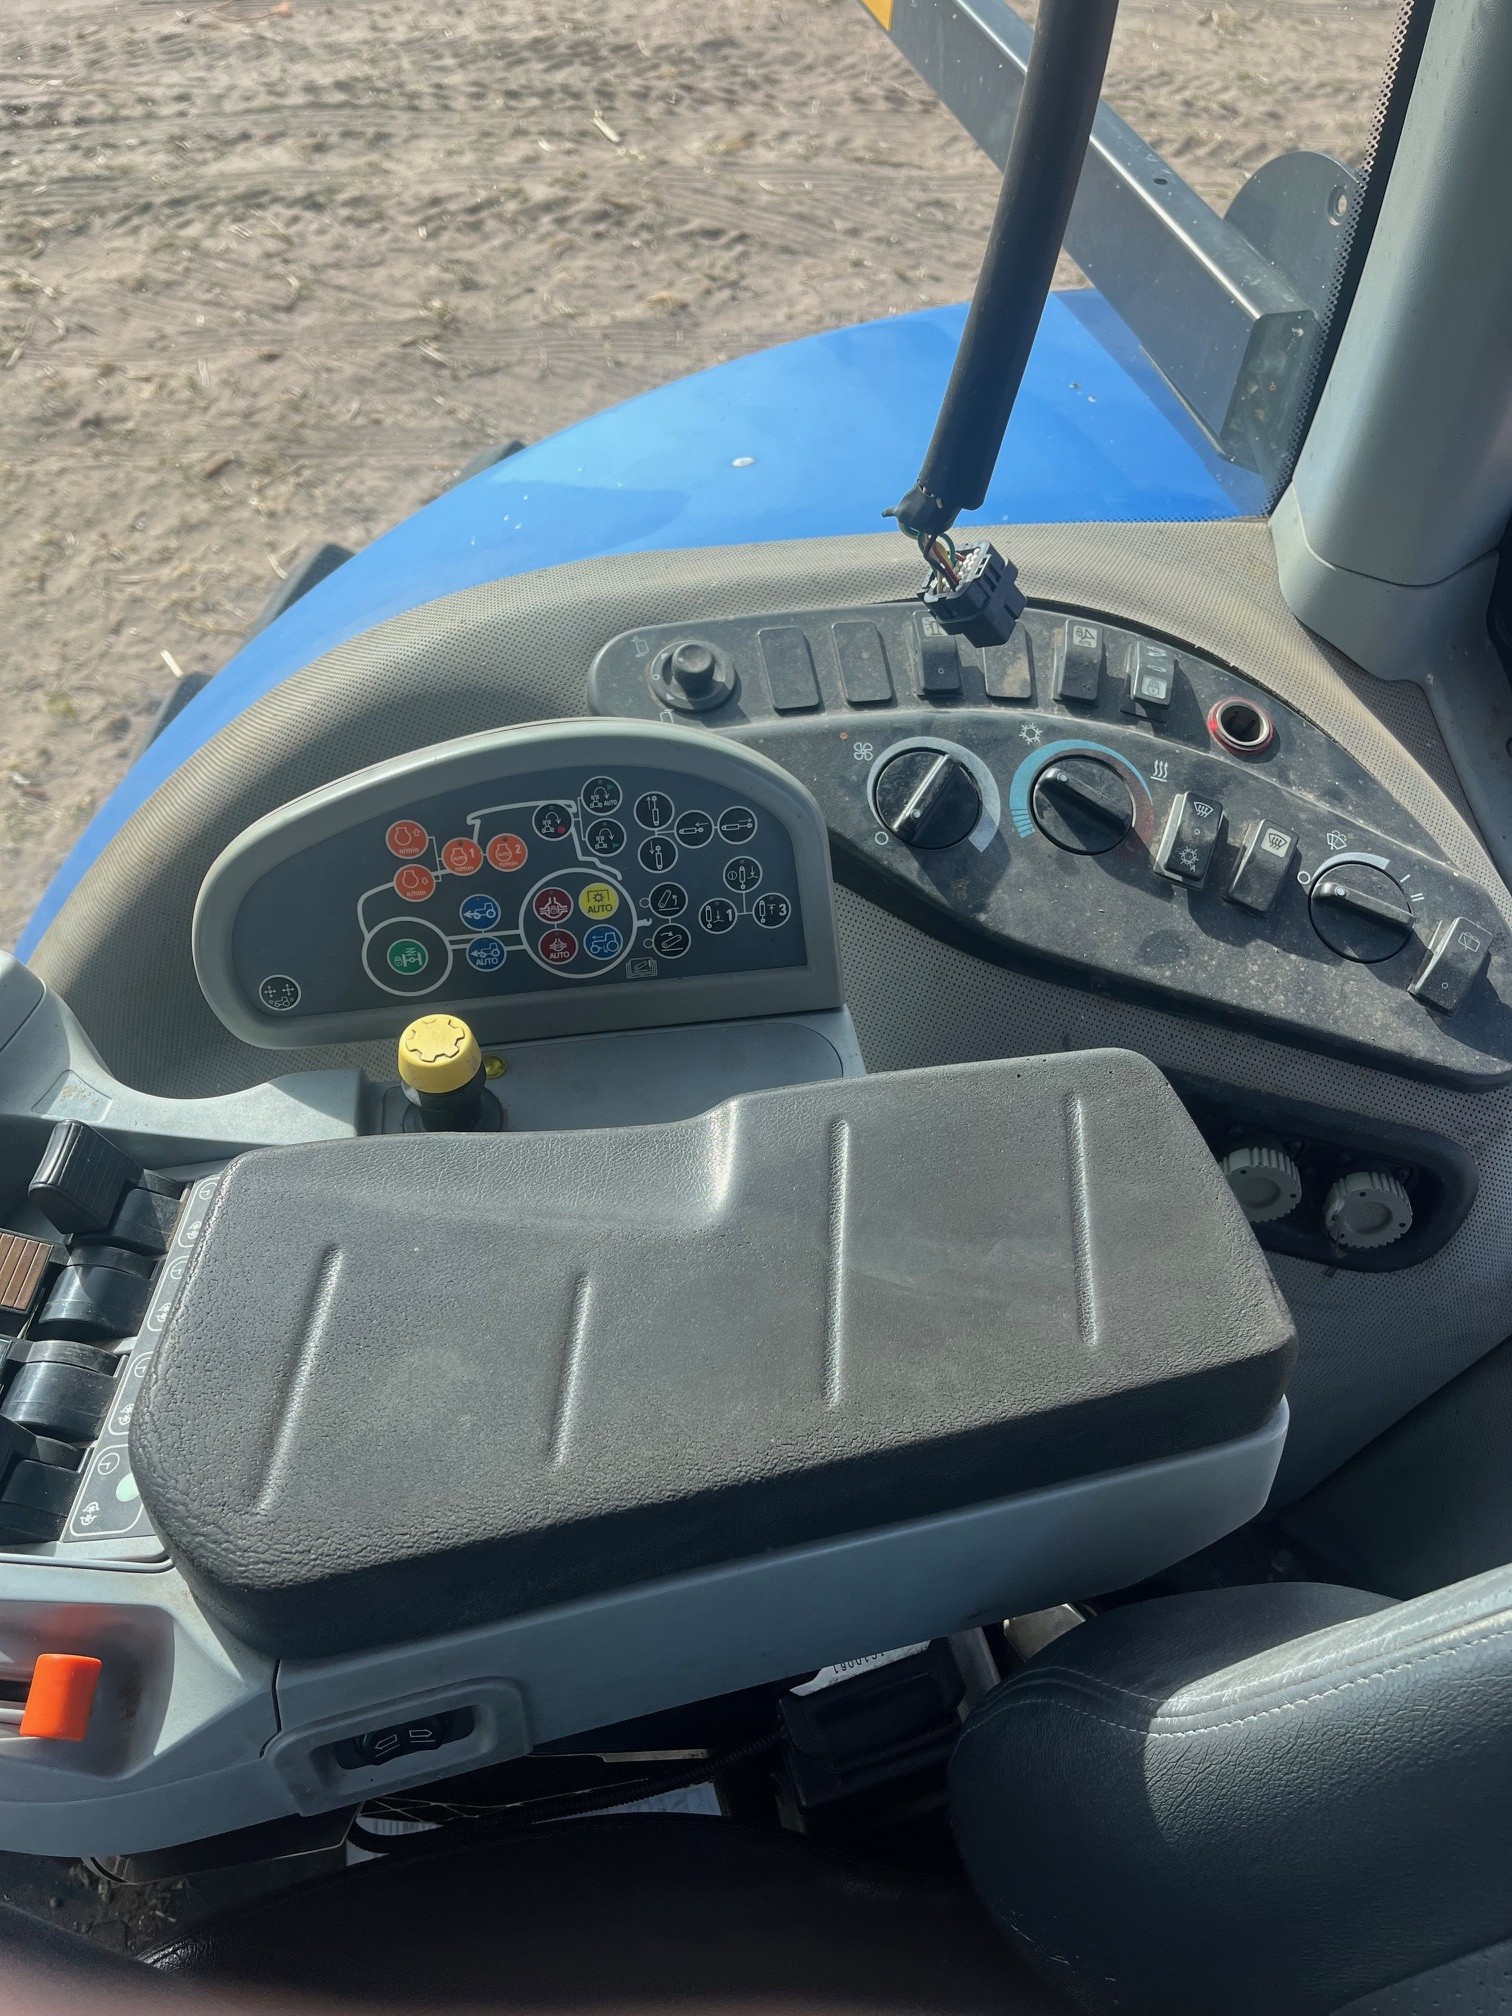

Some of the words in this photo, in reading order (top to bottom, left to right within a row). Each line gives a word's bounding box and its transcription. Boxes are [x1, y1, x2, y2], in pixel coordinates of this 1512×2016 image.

[603, 799, 618, 807] AUTO
[469, 848, 475, 858] 1
[514, 844, 522, 854] 2
[1189, 864, 1196, 872] A
[587, 903, 613, 914] AUTO
[778, 903, 787, 916] 3
[725, 908, 733, 922] 1
[549, 950, 570, 960] AUTO
[475, 957, 499, 966] AUTO
